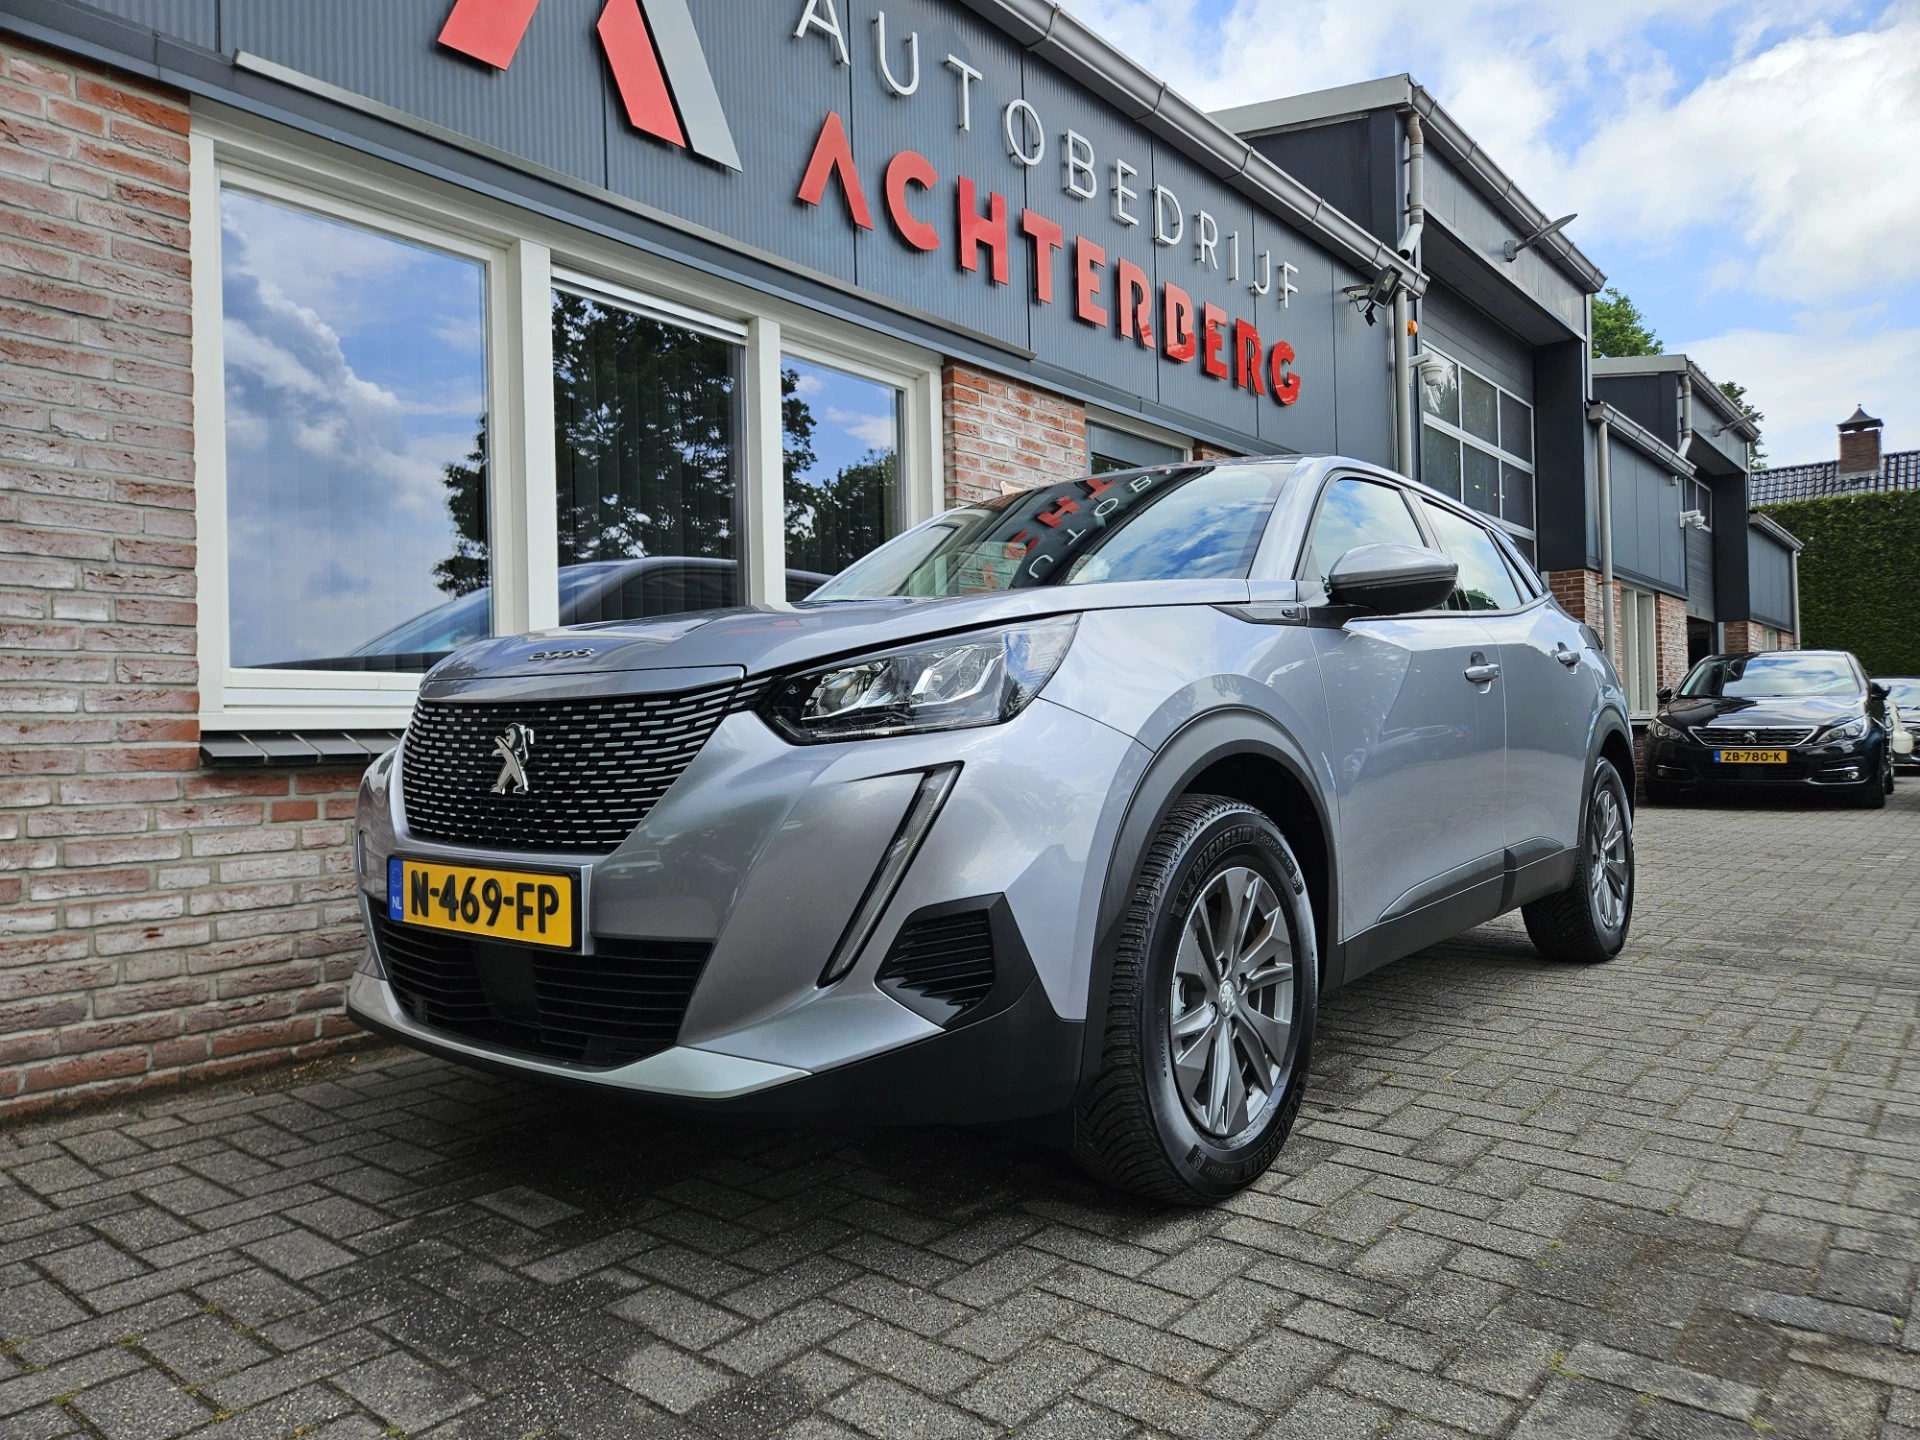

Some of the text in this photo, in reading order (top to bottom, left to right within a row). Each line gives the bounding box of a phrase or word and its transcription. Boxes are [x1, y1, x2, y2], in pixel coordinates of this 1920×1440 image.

[793, 0, 1299, 309] AUTOBEDRIJF
[798, 110, 1301, 406] ACHTERBERG
[1724, 751, 1782, 762] ZB-780-K
[1192, 826, 1253, 880] MICHELIN
[391, 895, 403, 911] NL
[410, 869, 560, 934] N-469-FP
